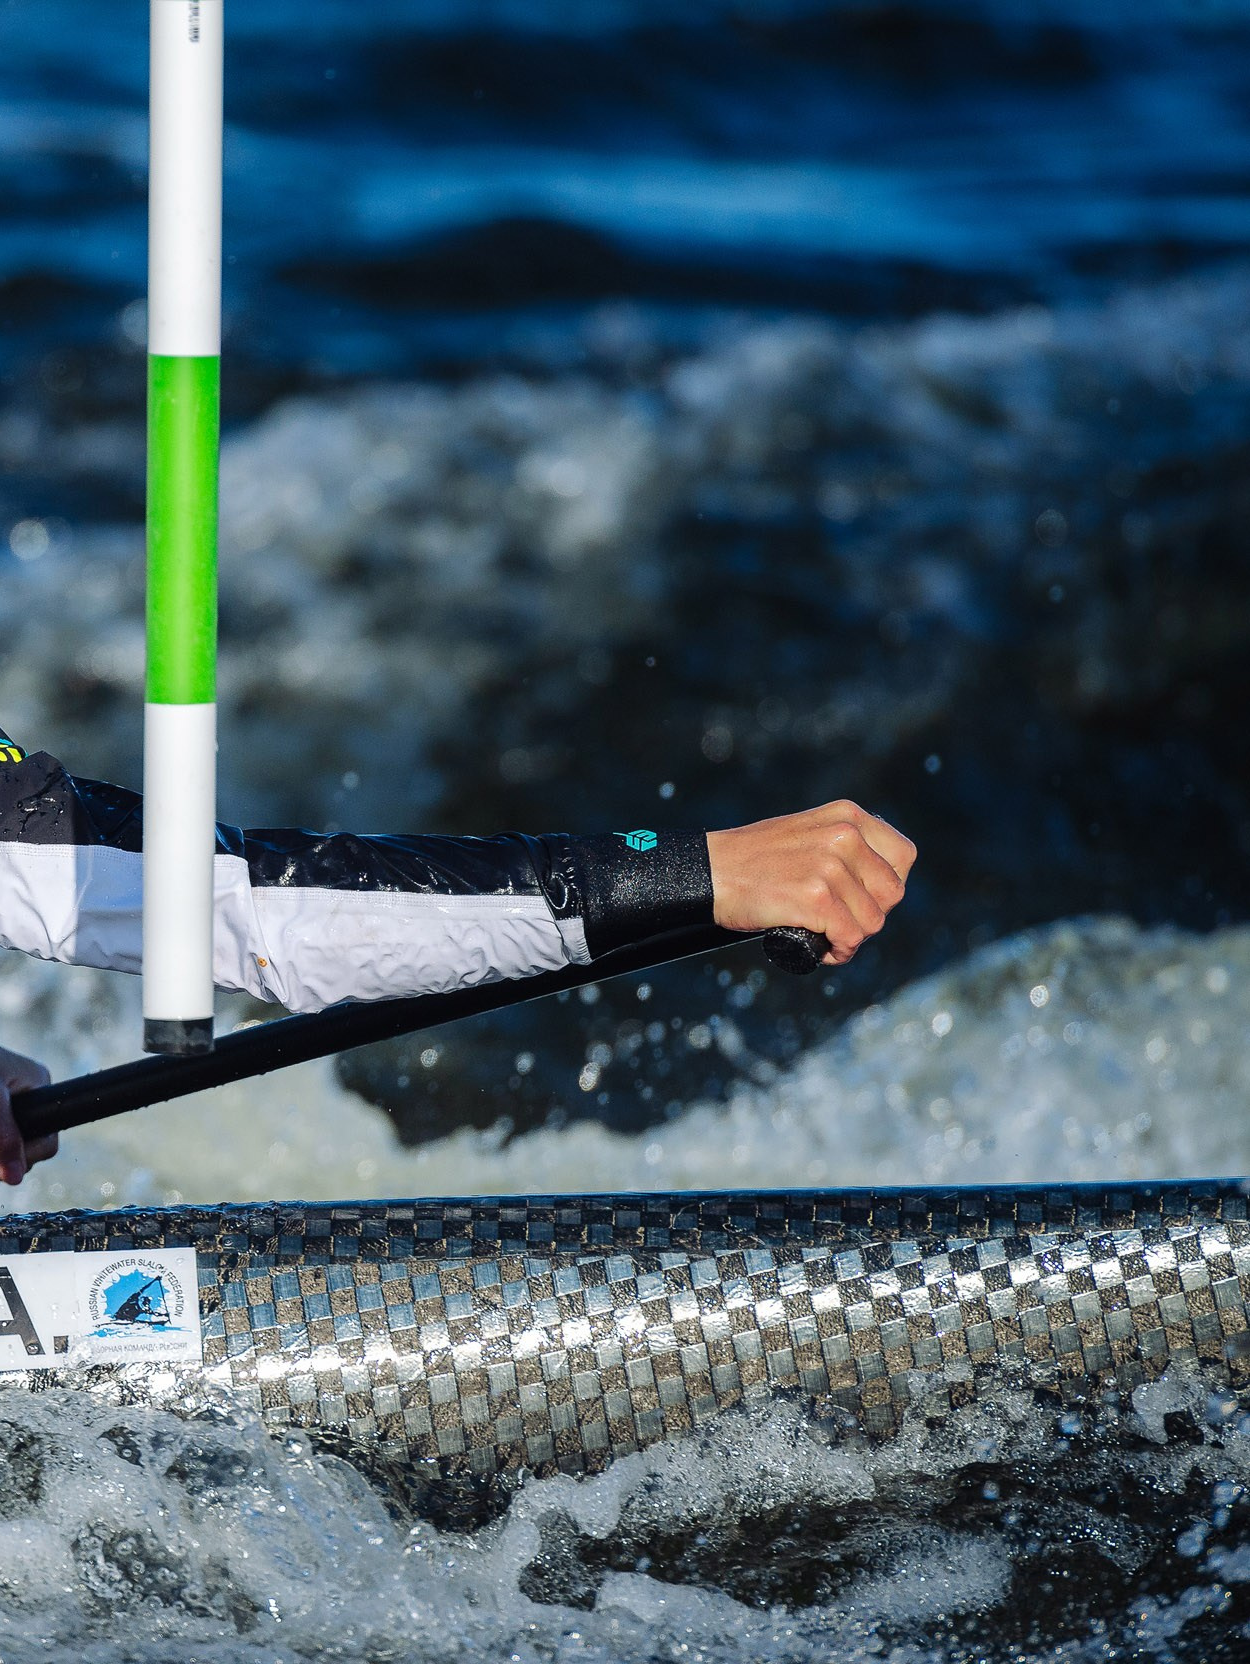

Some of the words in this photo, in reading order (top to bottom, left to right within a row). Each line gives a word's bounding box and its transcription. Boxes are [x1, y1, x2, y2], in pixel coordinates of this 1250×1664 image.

[92, 1258, 136, 1287] WHITEWATER
[89, 1287, 100, 1321] RUSSIAN
[165, 1271, 184, 1318] FEDERATION
